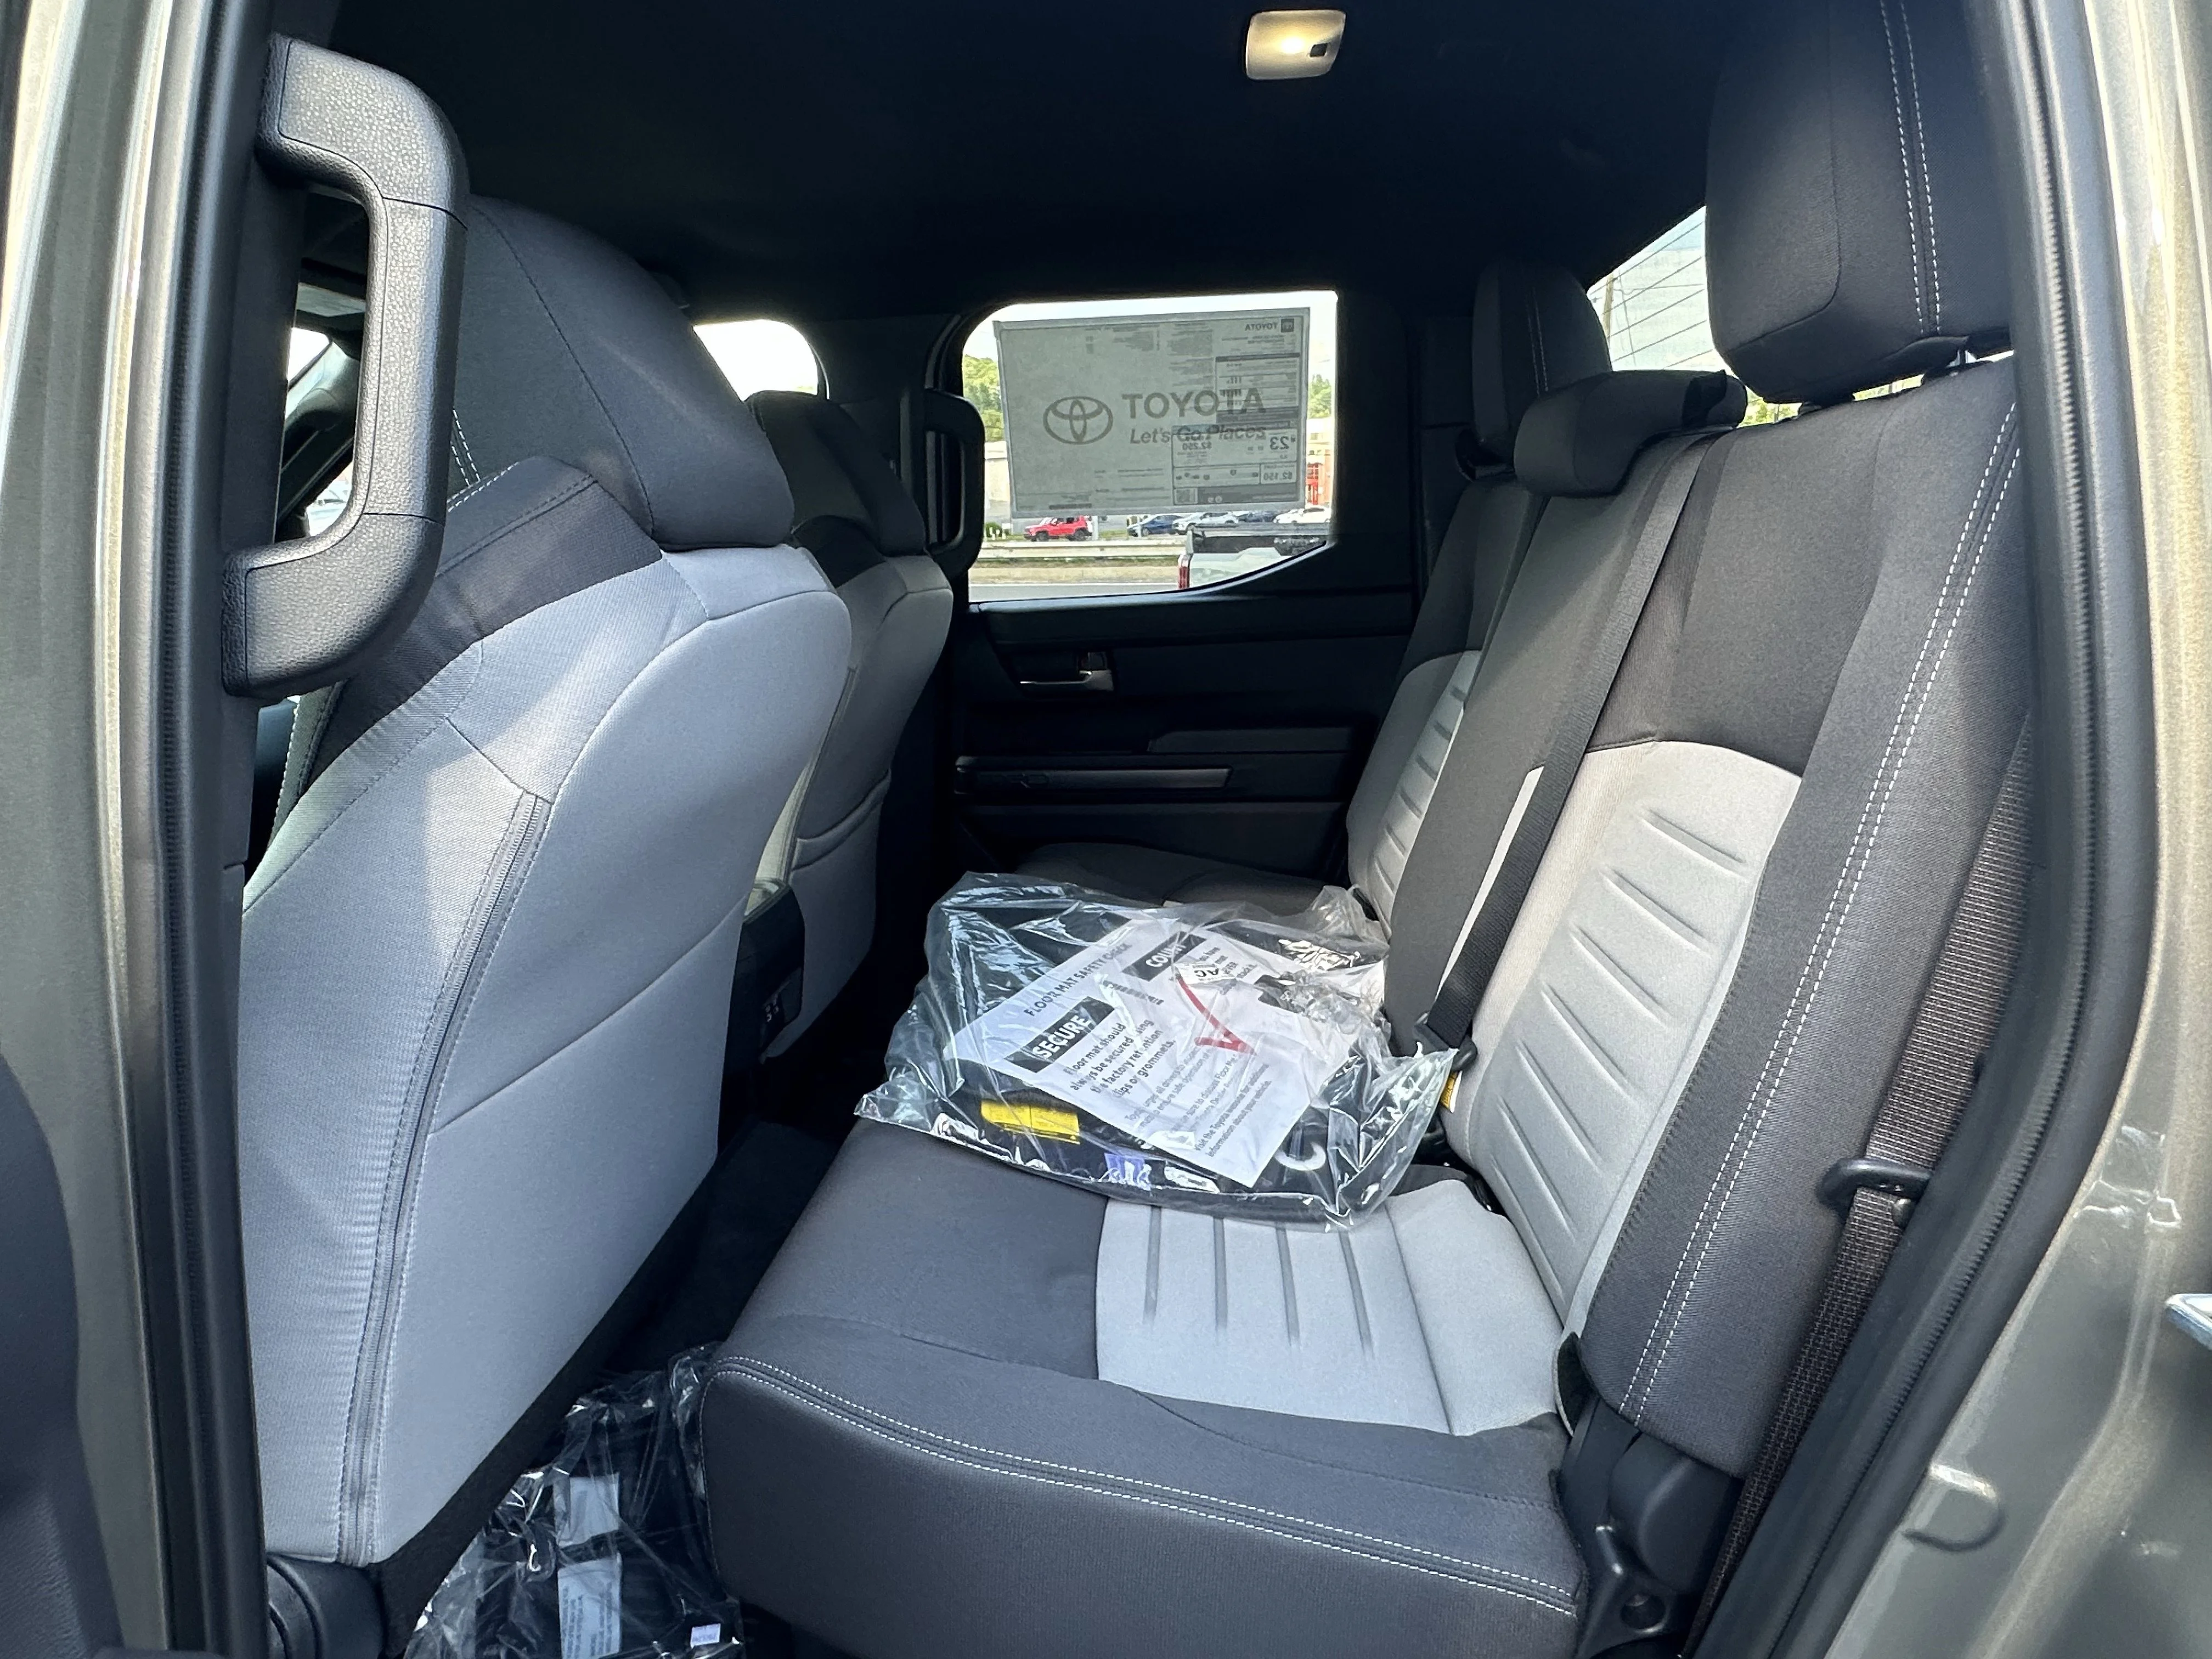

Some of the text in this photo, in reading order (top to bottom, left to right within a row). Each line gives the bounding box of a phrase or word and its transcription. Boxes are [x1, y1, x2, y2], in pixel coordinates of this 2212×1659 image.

[1122, 387, 1266, 419] TOYOTA
[1130, 427, 1171, 444] Let's
[1024, 991, 1062, 1015] FLOOR
[1055, 978, 1079, 992] MAT
[1075, 959, 1105, 979] SAFETY
[1032, 1017, 1091, 1058] SECURE
[1063, 1023, 1127, 1075] Floor mat should
[1092, 1060, 1108, 1071] be
[1102, 1037, 1135, 1062] secured
[1133, 1019, 1155, 1036] sing
[1103, 1059, 1135, 1084] factory
[1137, 1040, 1178, 1076] grommets.
